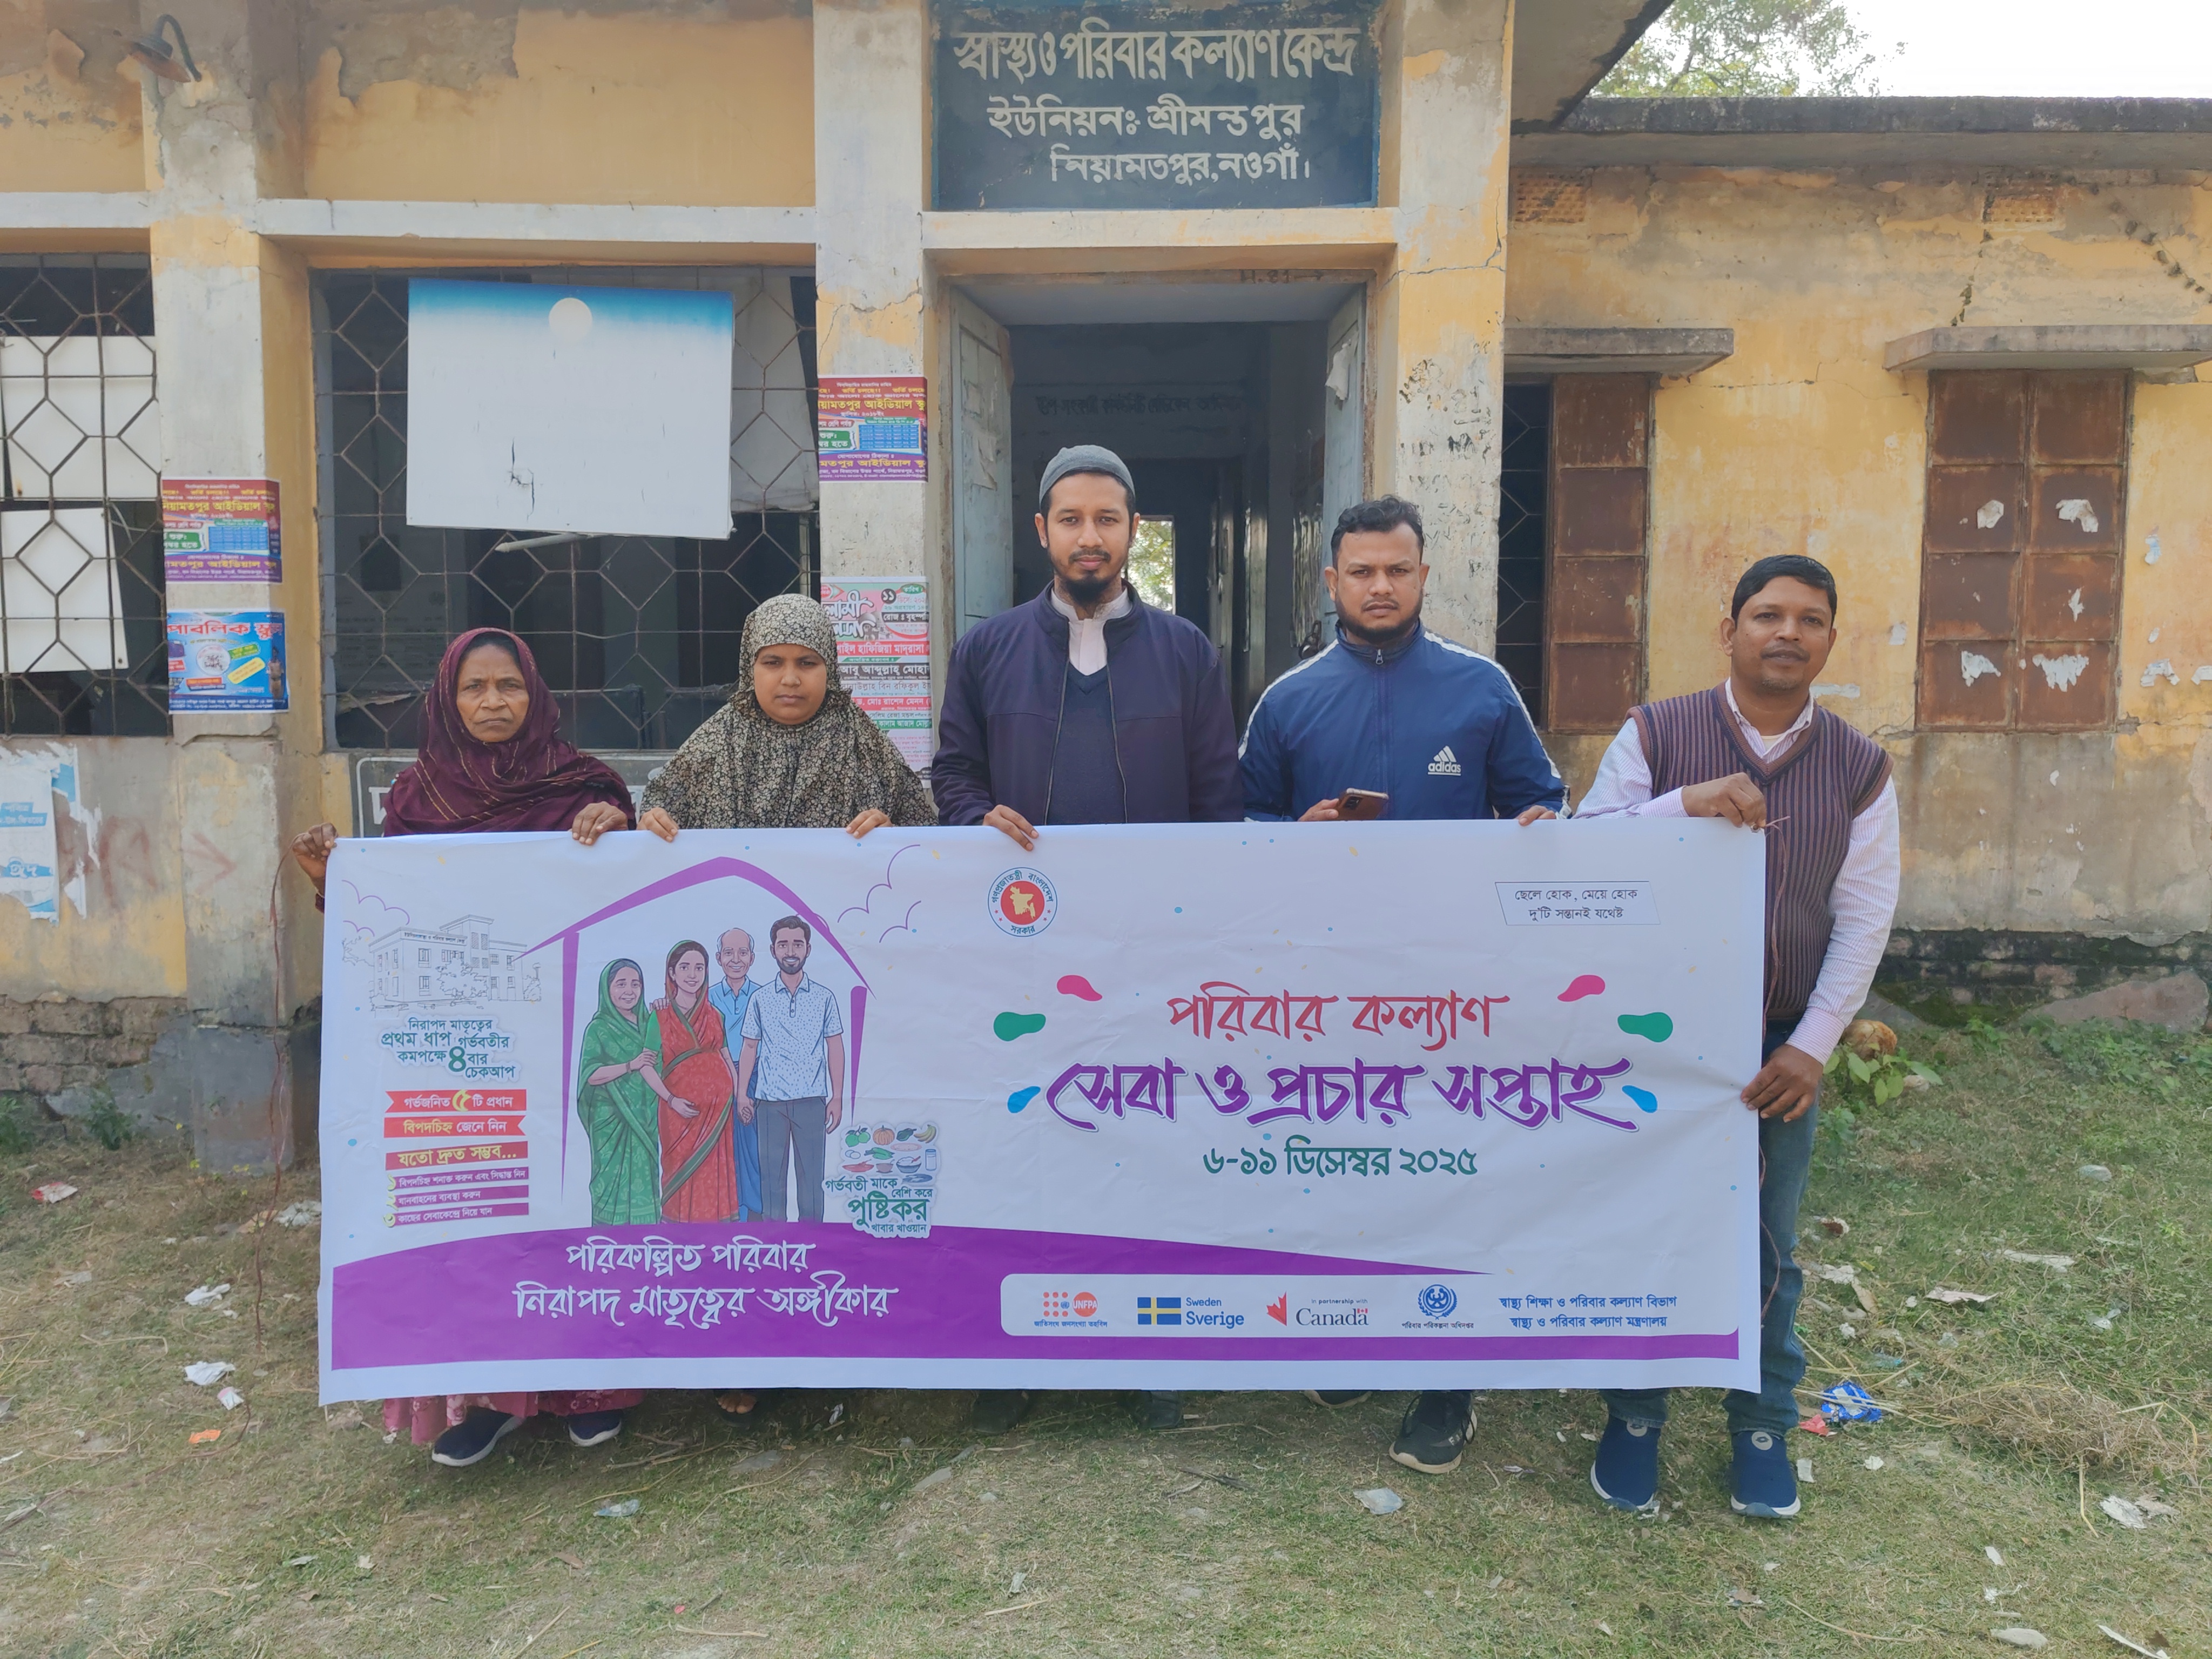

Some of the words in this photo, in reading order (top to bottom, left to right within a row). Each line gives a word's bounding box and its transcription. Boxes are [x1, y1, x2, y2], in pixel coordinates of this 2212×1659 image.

[1037, 31, 1056, 77] ও
[1059, 16, 1166, 81] পরিবার
[1170, 30, 1278, 83] কল্যাণ
[1282, 27, 1360, 79] কেন্দ্র
[818, 400, 860, 412] য়ামতপুর
[864, 398, 913, 410] আইডিয়াল
[819, 460, 853, 468] মতপুর
[857, 458, 911, 468] আইডিয়াল
[882, 590, 895, 601] ১১
[167, 620, 251, 635] পাবলিক
[902, 665, 930, 675] মোহা
[879, 681, 891, 690] বিন
[1428, 761, 1461, 773] adidas
[1028, 873, 1054, 902] বাংলাদেশ
[1515, 890, 1542, 901] ছেলে
[1582, 889, 1608, 901] মেয়ে
[1611, 889, 1638, 900] হোক
[1555, 906, 1591, 920] সন্তানই
[1595, 906, 1624, 919] যথেষ্ট
[1010, 925, 1036, 935] সরকার
[1166, 981, 1339, 1042] পরিবার
[1347, 989, 1510, 1051] কল্যাণ
[408, 1017, 446, 1030] নিরাপদ
[449, 1019, 493, 1034] মাতৃত্বের
[381, 1031, 417, 1048] প্রথম
[424, 1030, 452, 1047] ধাপ
[458, 1033, 510, 1049] গর্ভবতীর
[397, 1050, 448, 1063] কমপক্ষে
[448, 1046, 467, 1073] ৪
[467, 1053, 488, 1065] বার
[465, 1065, 516, 1079] চেকআপ
[403, 1094, 451, 1109] গর্ভজনিত
[452, 1089, 471, 1112] ৫
[472, 1094, 484, 1108] টি
[486, 1096, 514, 1108] প্রধান
[1046, 1056, 1188, 1131] সেবা
[1194, 1064, 1252, 1116] ও
[1246, 1056, 1427, 1127] প্রচার
[1431, 1056, 1640, 1131] সপ্তাহ
[456, 1121, 485, 1134] জেনে
[487, 1117, 508, 1132] নিন
[397, 1149, 433, 1167] যতো
[436, 1148, 467, 1165] দ্রুত
[1203, 1147, 1277, 1176] ৬-১১
[1284, 1135, 1392, 1178] ডিসেম্বর
[1399, 1148, 1478, 1176] ২০২৫
[387, 1174, 396, 1191] ১
[455, 1174, 473, 1182] করুন
[475, 1172, 490, 1181] এবং
[513, 1169, 526, 1178] নিন
[825, 1175, 868, 1192] গর্ভবতী
[869, 1177, 899, 1189] মাকে
[386, 1192, 399, 1211] ২
[462, 1190, 481, 1199] করুন
[891, 1186, 912, 1198] বেশি
[913, 1189, 933, 1198] করে
[480, 1207, 493, 1216] যান
[847, 1190, 930, 1229] পুষ্টিকর
[871, 1224, 895, 1233] খাবার
[896, 1224, 927, 1233] খাওয়ান
[565, 1235, 706, 1277] পরিকল্পিত
[711, 1237, 817, 1274] পরিবার
[511, 1280, 625, 1327] নিরাপদ
[630, 1285, 756, 1330] মাতৃত্বের
[756, 1270, 900, 1327] অঙ্গীকার
[1073, 1299, 1098, 1310] UNFPA
[1186, 1297, 1222, 1307] Sweden
[1499, 1297, 1522, 1311] স্বাস্থ্য
[1526, 1294, 1554, 1309] শিক্ষা
[1556, 1298, 1566, 1307] ও
[1569, 1294, 1606, 1309] পরিবার
[1610, 1296, 1643, 1308] কল্যাণ
[1646, 1294, 1678, 1307] বিভাগ
[1186, 1311, 1244, 1329] Sverige
[1296, 1307, 1369, 1326] Canada
[1401, 1321, 1421, 1329] পরিবার
[1509, 1317, 1533, 1331] স্বাস্থ্য
[1536, 1318, 1545, 1327] ও
[1549, 1313, 1586, 1328] পরিবার
[1589, 1316, 1623, 1328] কল্যাণ
[1626, 1316, 1668, 1328] মন্ত্রণালয়
